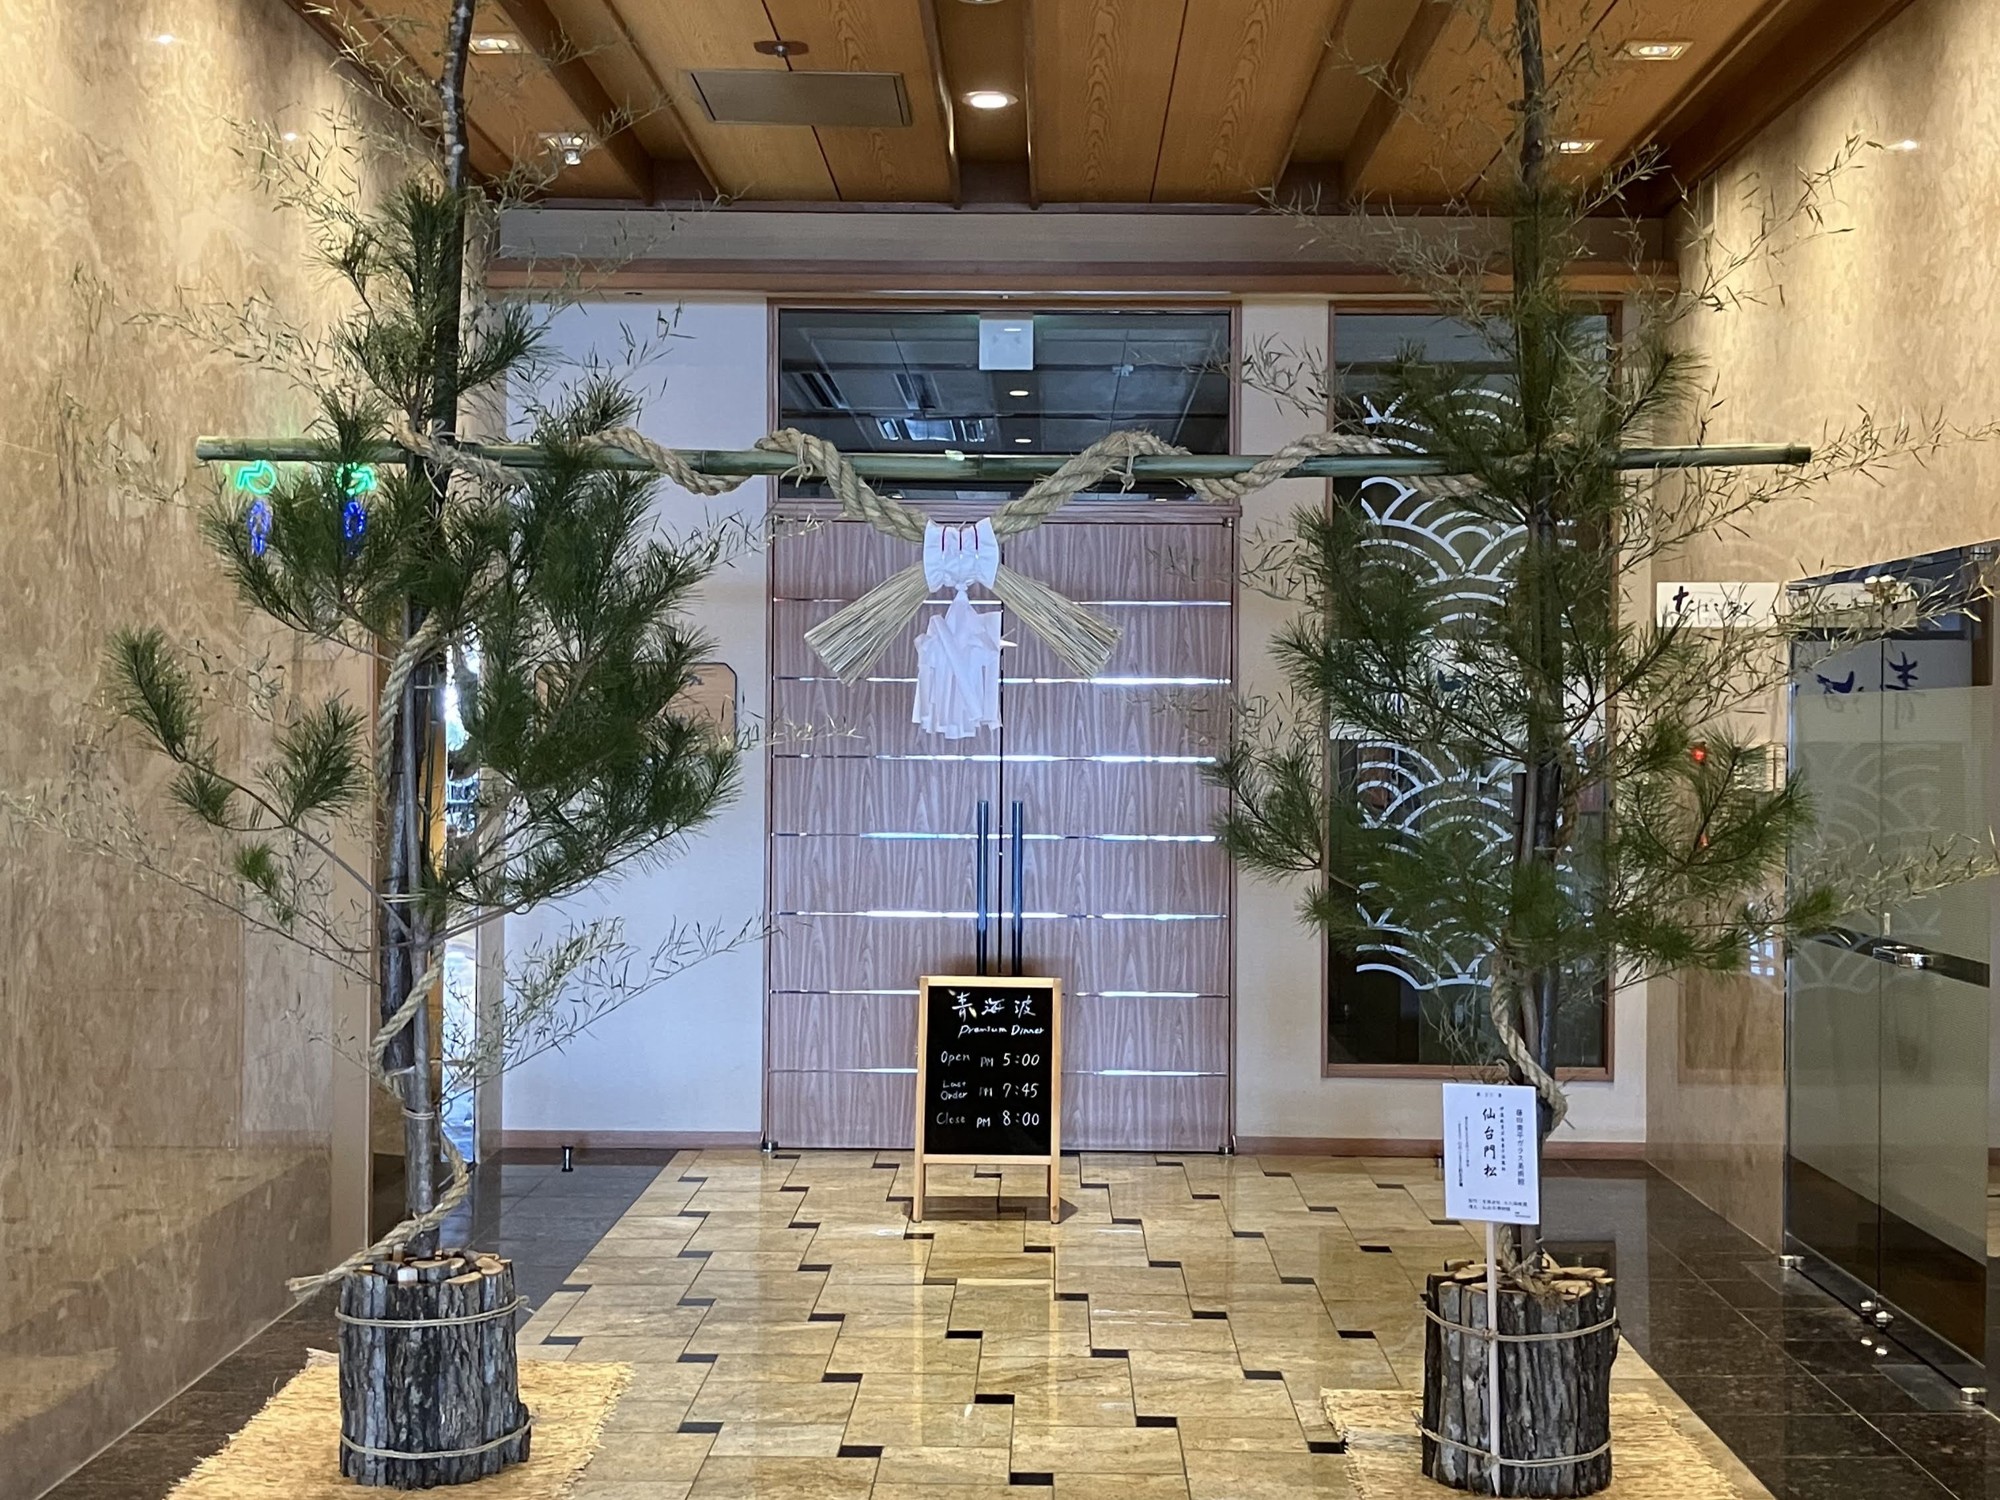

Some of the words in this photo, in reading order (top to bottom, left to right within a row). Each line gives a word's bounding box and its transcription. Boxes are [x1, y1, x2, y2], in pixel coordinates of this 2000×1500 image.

[1010, 1024, 1045, 1037] Dinner
[940, 1050, 971, 1067] Open
[1002, 1052, 1040, 1067] 5:00
[940, 1090, 968, 1101] Order
[1002, 1082, 1040, 1098] 7:45
[942, 1080, 967, 1089] Last
[936, 1111, 966, 1125] Close
[1002, 1109, 1040, 1126] 8:00
[1482, 1107, 1498, 1177] 仙台門松
